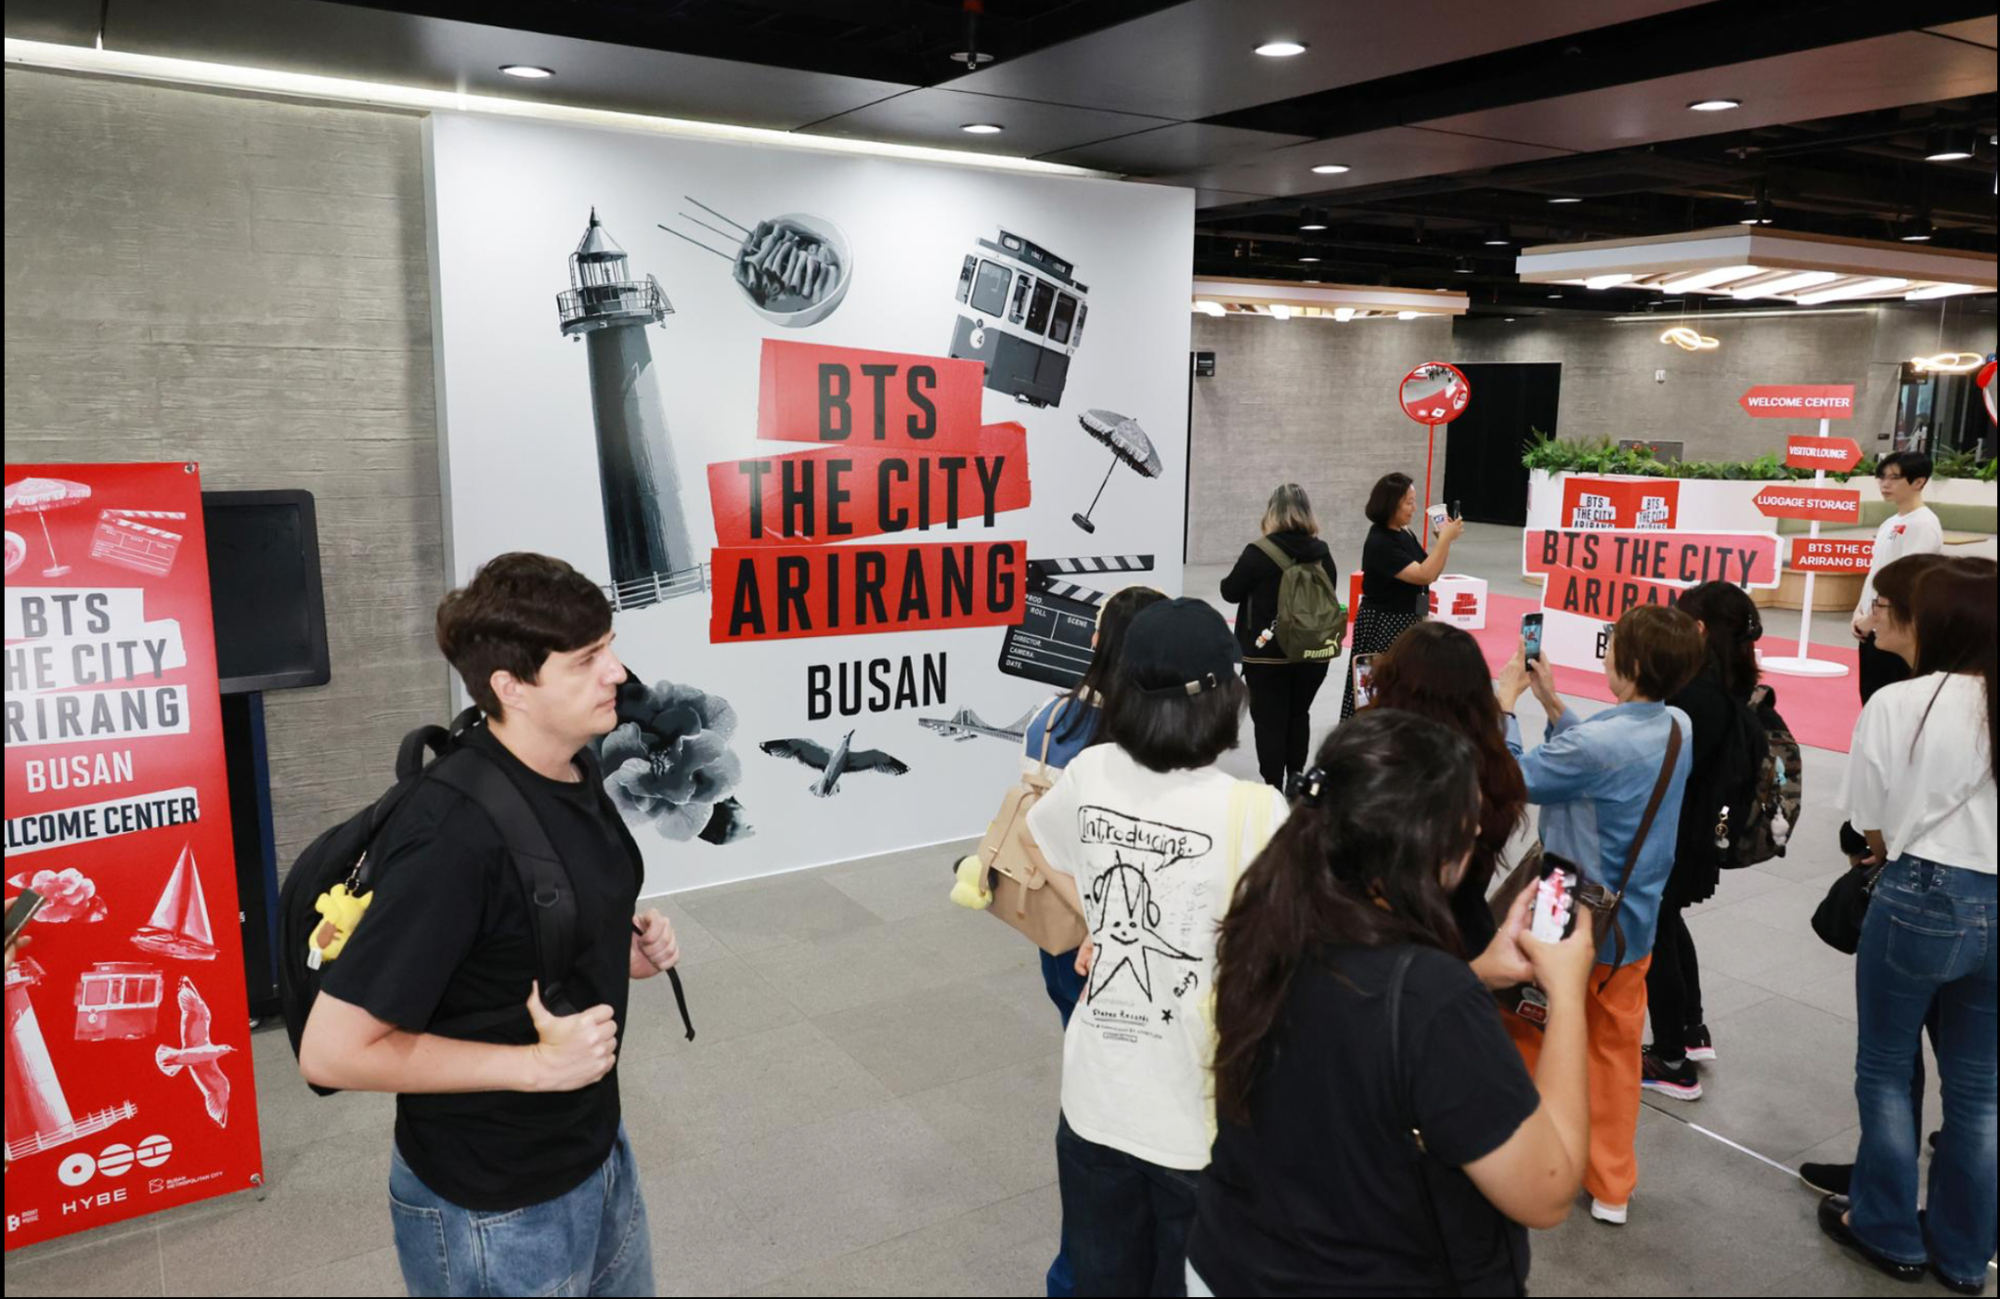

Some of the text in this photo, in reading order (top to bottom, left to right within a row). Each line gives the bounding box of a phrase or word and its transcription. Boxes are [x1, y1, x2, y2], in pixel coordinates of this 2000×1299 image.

[818, 363, 937, 441] BTS
[1748, 397, 1850, 408] WELCOME CENTER
[1789, 446, 1848, 459] VISITOR LOUNGE
[739, 455, 1005, 539] THE CITY
[1577, 508, 1613, 521] THE CITY
[1586, 496, 1604, 508] BTS
[1646, 498, 1660, 510] BTS
[1757, 495, 1857, 512] LUGGAGE STORAGE
[1542, 529, 1759, 589] BTS THE CITY
[1798, 556, 1853, 566] ARIRANG
[1808, 543, 1832, 553] BTS
[1835, 544, 1859, 554] THE
[728, 543, 1015, 637] ARIRANG
[21, 592, 110, 638] BTS
[1030, 606, 1088, 628] ROLL SCENE
[5, 638, 167, 691] HE CITY
[807, 652, 947, 720] BUSAN
[5, 686, 180, 743] RIRANG
[26, 750, 134, 793] BUSAN
[5, 797, 198, 848] LCOME CENTER
[62, 1188, 127, 1215] HYBE
